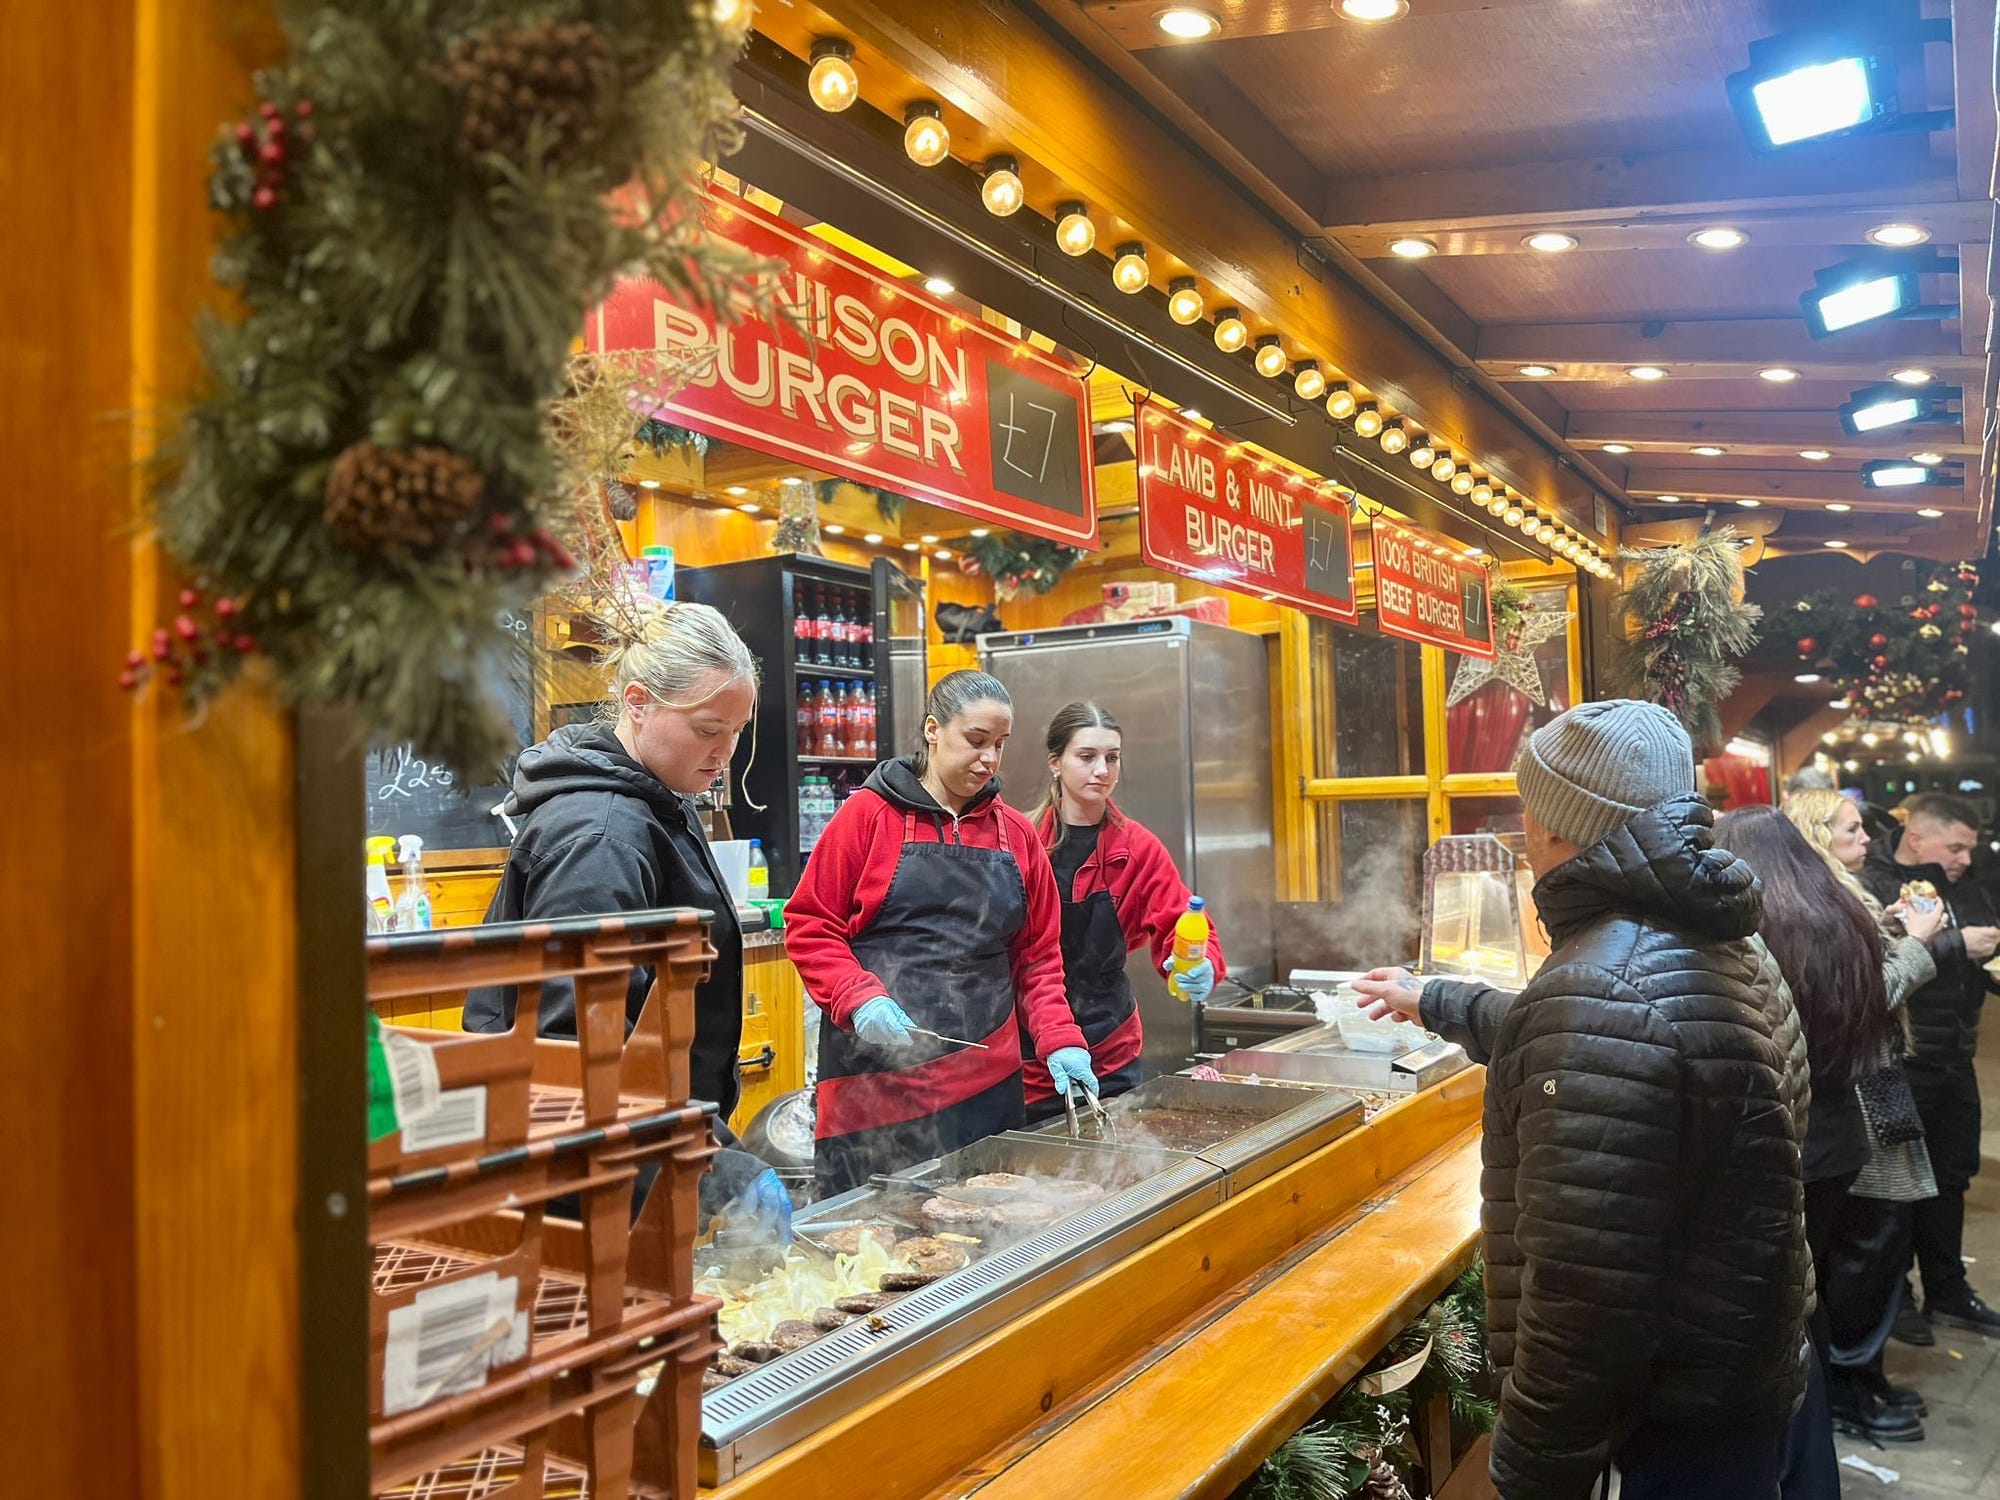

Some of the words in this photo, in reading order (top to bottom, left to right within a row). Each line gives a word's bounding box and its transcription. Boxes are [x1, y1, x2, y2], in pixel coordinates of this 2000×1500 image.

[704, 229, 970, 405] NISON
[653, 298, 966, 476] BURGER
[1151, 433, 1217, 500] LAMB
[1225, 469, 1241, 509] &
[1248, 479, 1295, 531] MINT
[1183, 504, 1276, 577] BURGER
[1379, 536, 1411, 575] 100%
[1412, 551, 1458, 593] BRITISH
[1381, 578, 1412, 616] BEEF
[1416, 592, 1461, 631] BURGER
